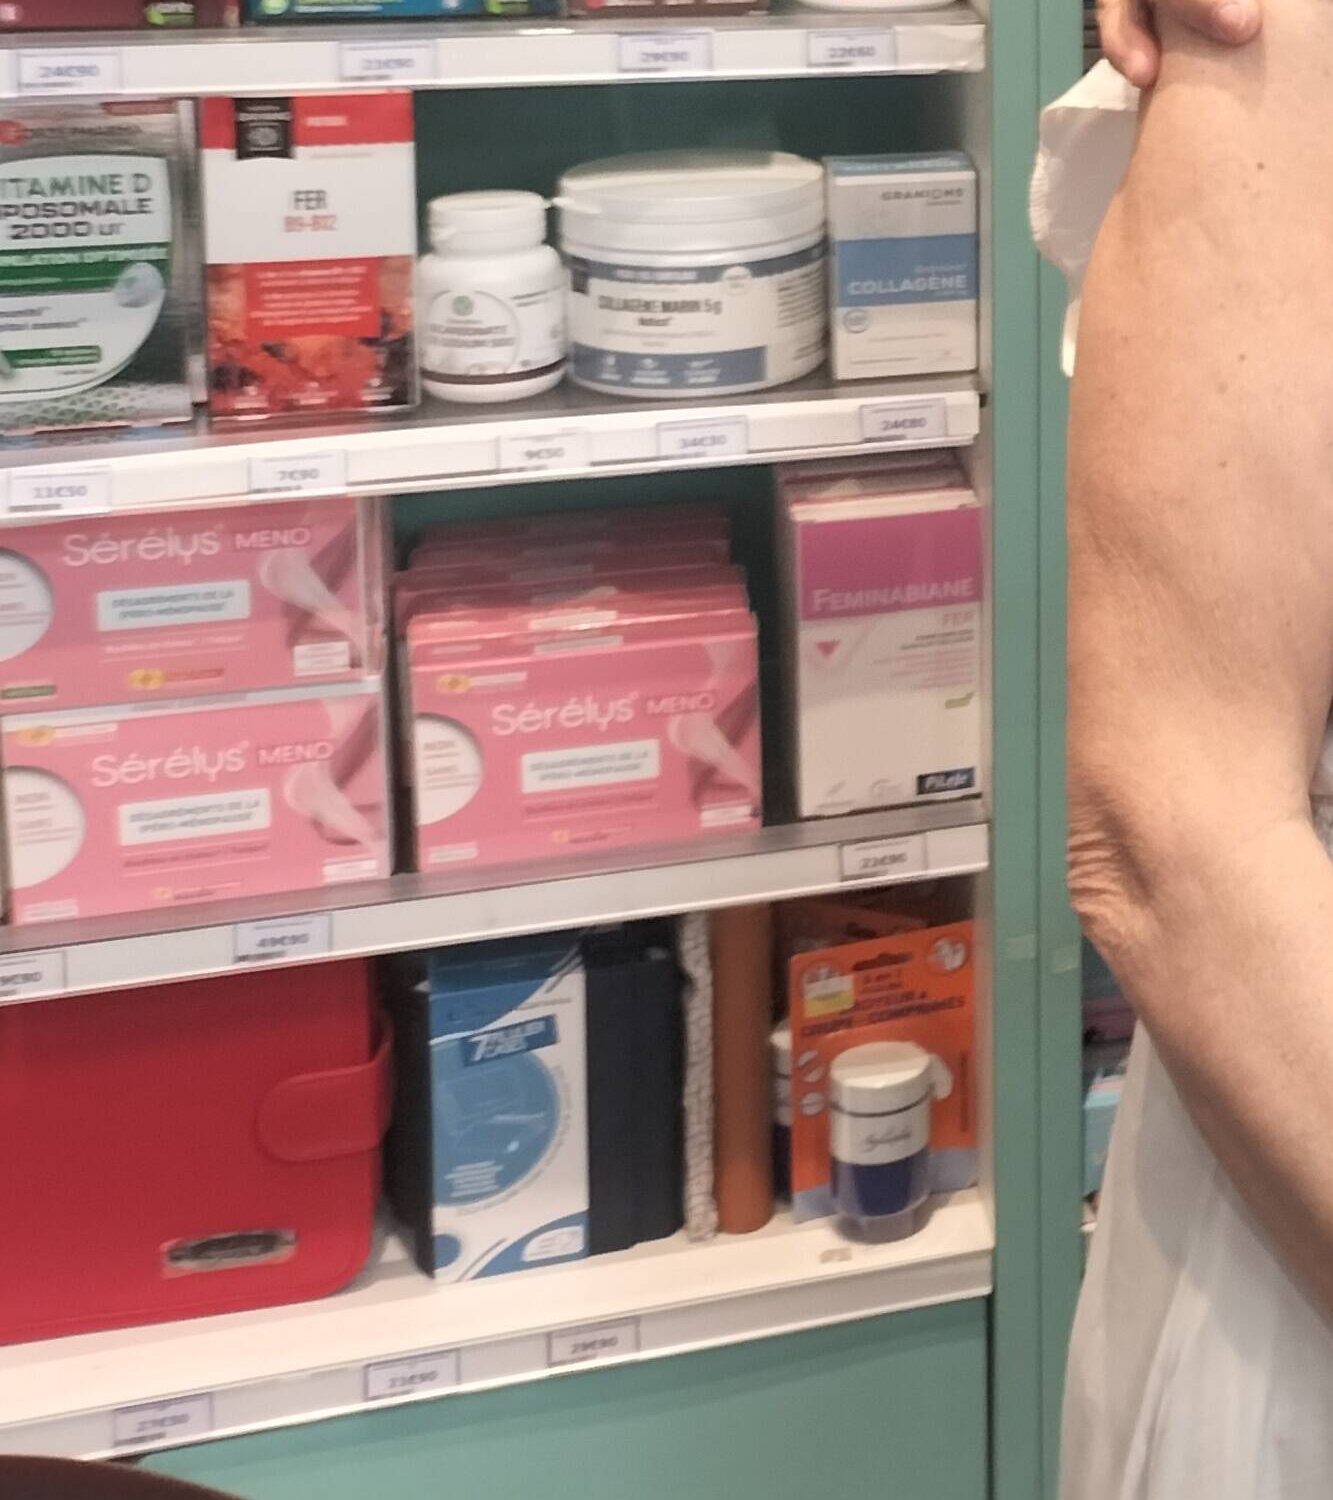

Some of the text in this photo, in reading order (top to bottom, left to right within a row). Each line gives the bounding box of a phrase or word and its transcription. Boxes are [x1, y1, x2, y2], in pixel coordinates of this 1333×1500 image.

[132, 172, 152, 194] D
[294, 190, 327, 211] FER
[11, 221, 92, 241] 2000
[63, 525, 312, 567] Sérélys MENO
[812, 577, 974, 612] FEMINABIANE
[491, 694, 638, 736] Sérélys
[92, 741, 335, 788] Sérélys MENO
